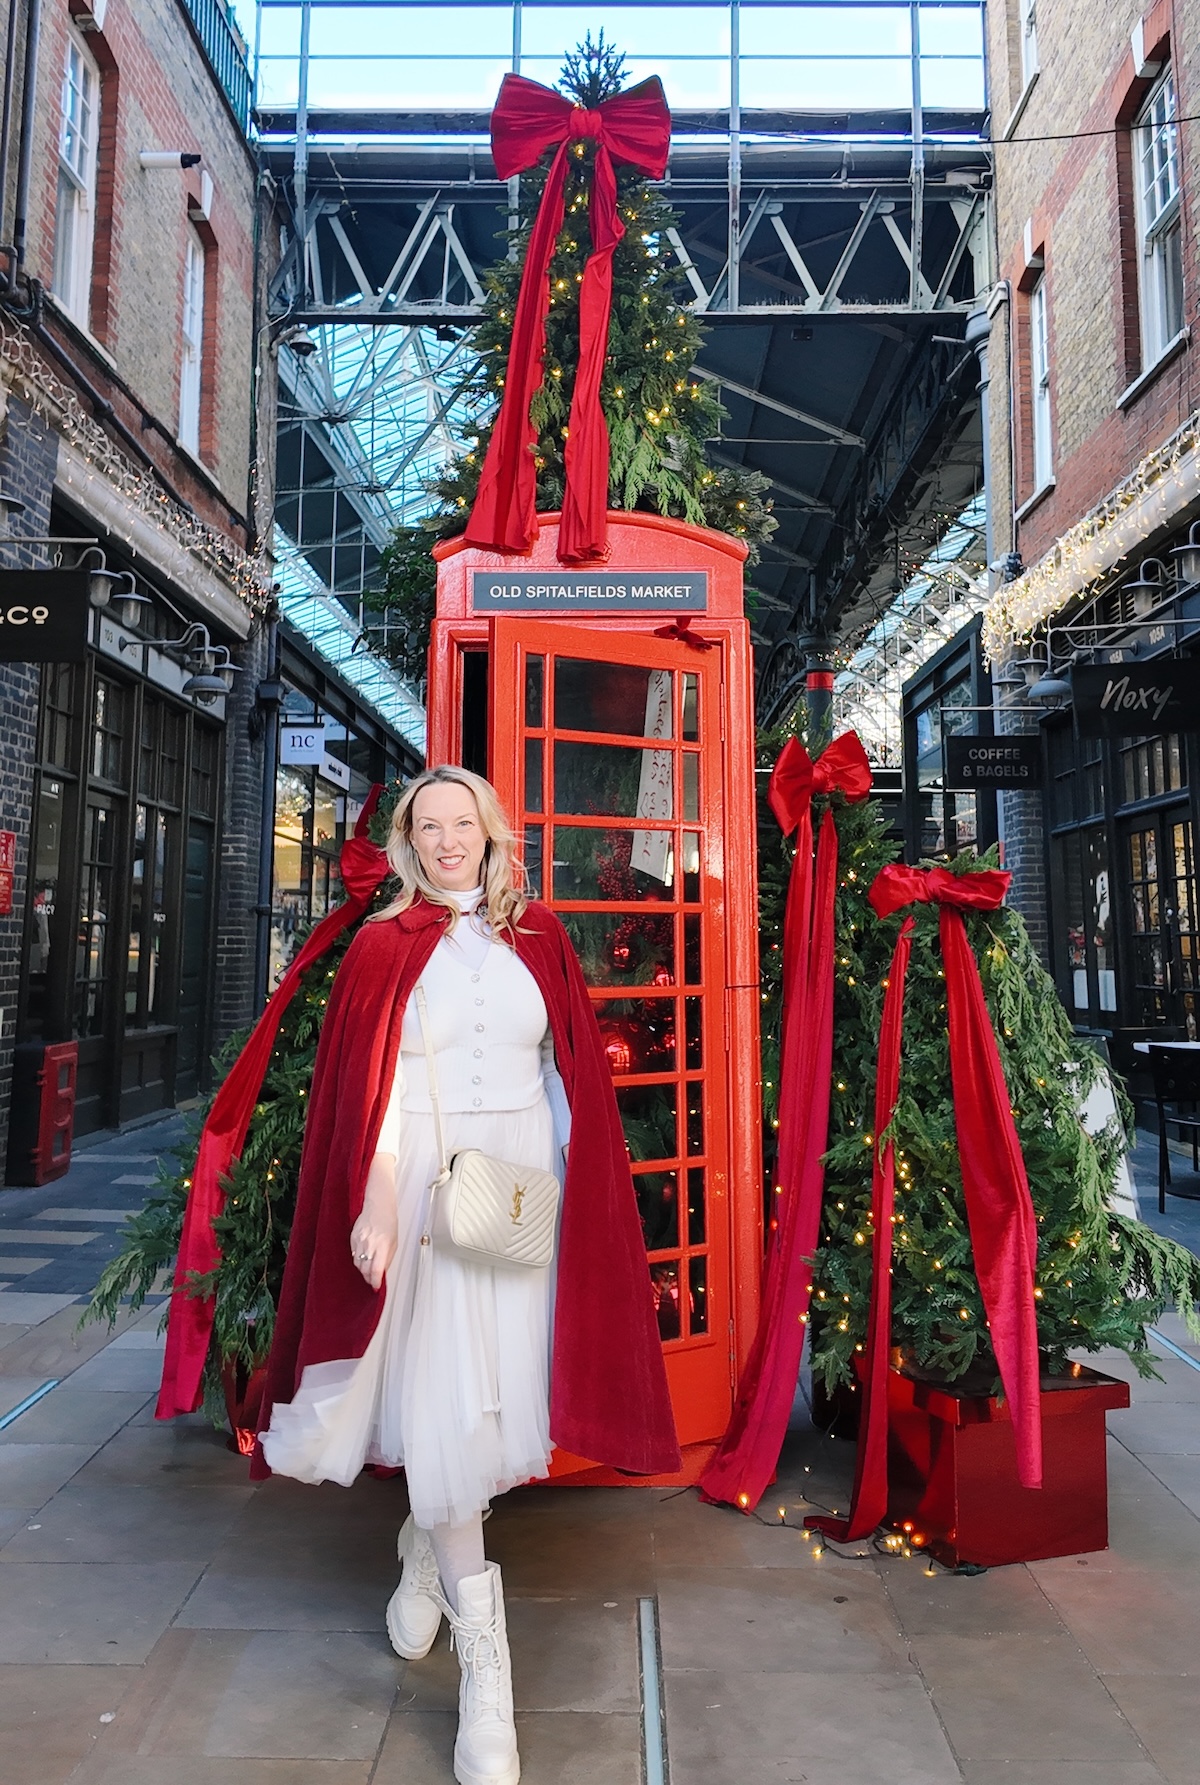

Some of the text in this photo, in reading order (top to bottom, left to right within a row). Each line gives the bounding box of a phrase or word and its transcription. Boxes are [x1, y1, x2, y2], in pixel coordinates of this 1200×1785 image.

[489, 585, 692, 598] OLD SPITALFIELDS MARKET
[290, 734, 315, 748] nc
[968, 748, 1021, 760] COFFEE
[962, 765, 1029, 777] & BAGELS
